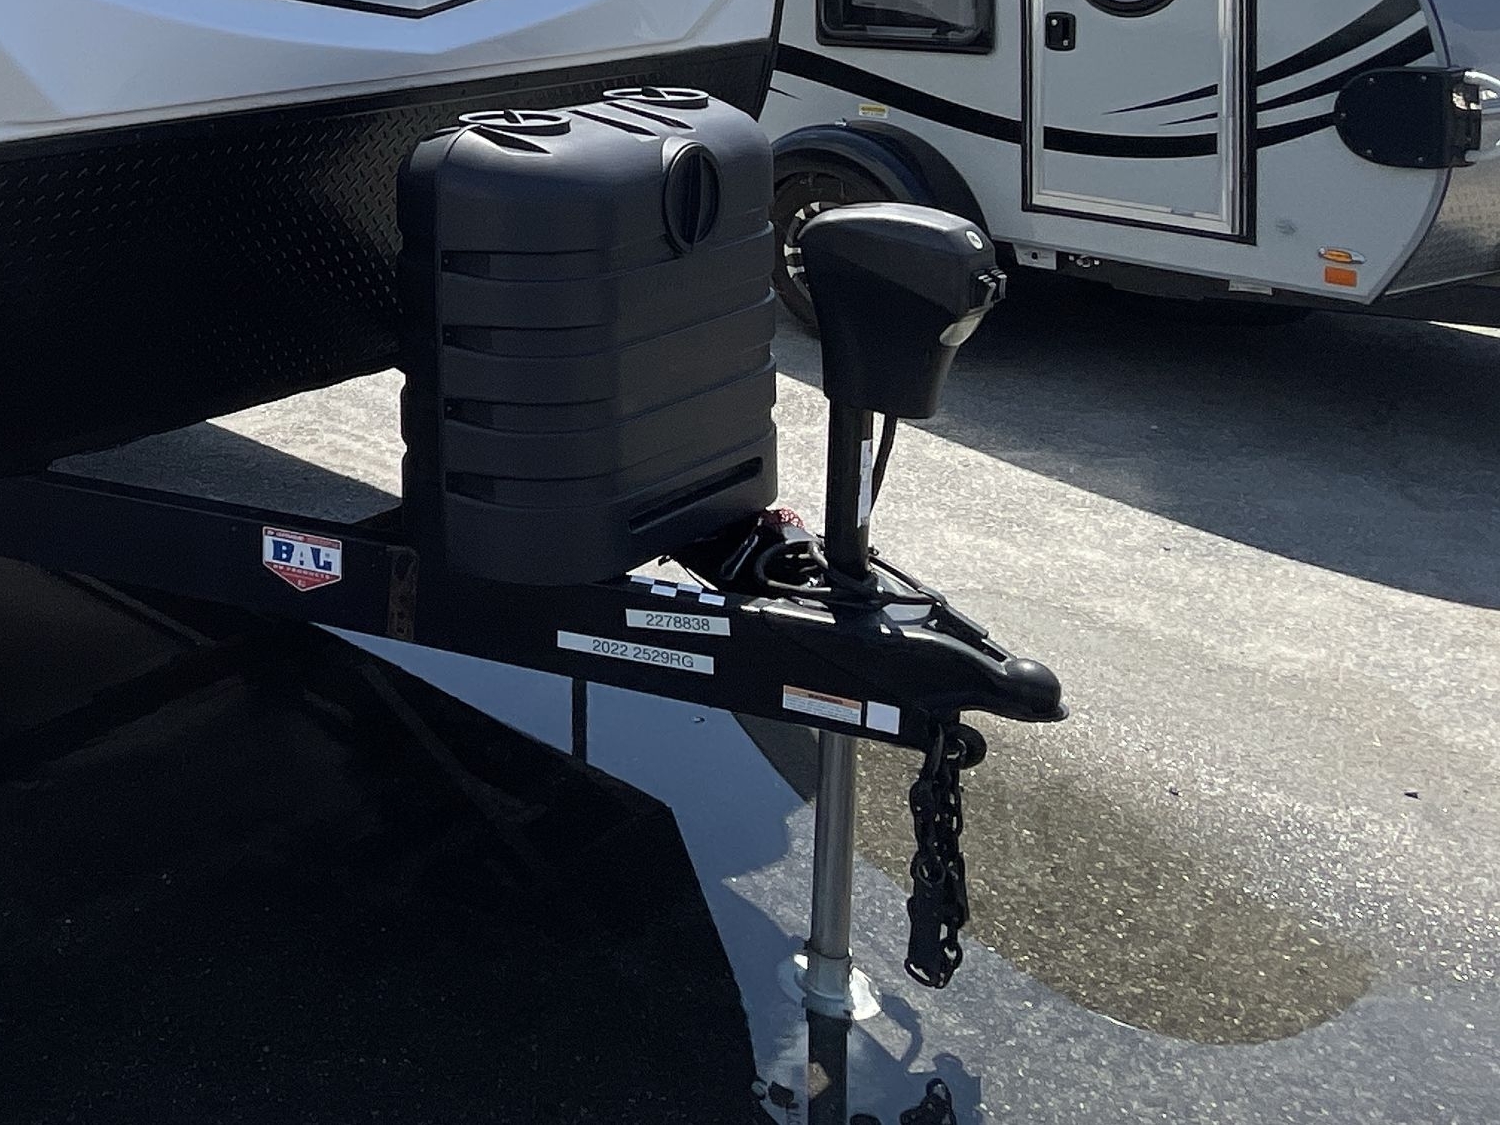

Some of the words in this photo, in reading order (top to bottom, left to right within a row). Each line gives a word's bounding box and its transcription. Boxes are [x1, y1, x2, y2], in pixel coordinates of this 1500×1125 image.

[272, 539, 332, 571] BAL
[645, 613, 711, 632] 2278838
[592, 638, 629, 658] 2022
[632, 646, 695, 668] 2529RG
